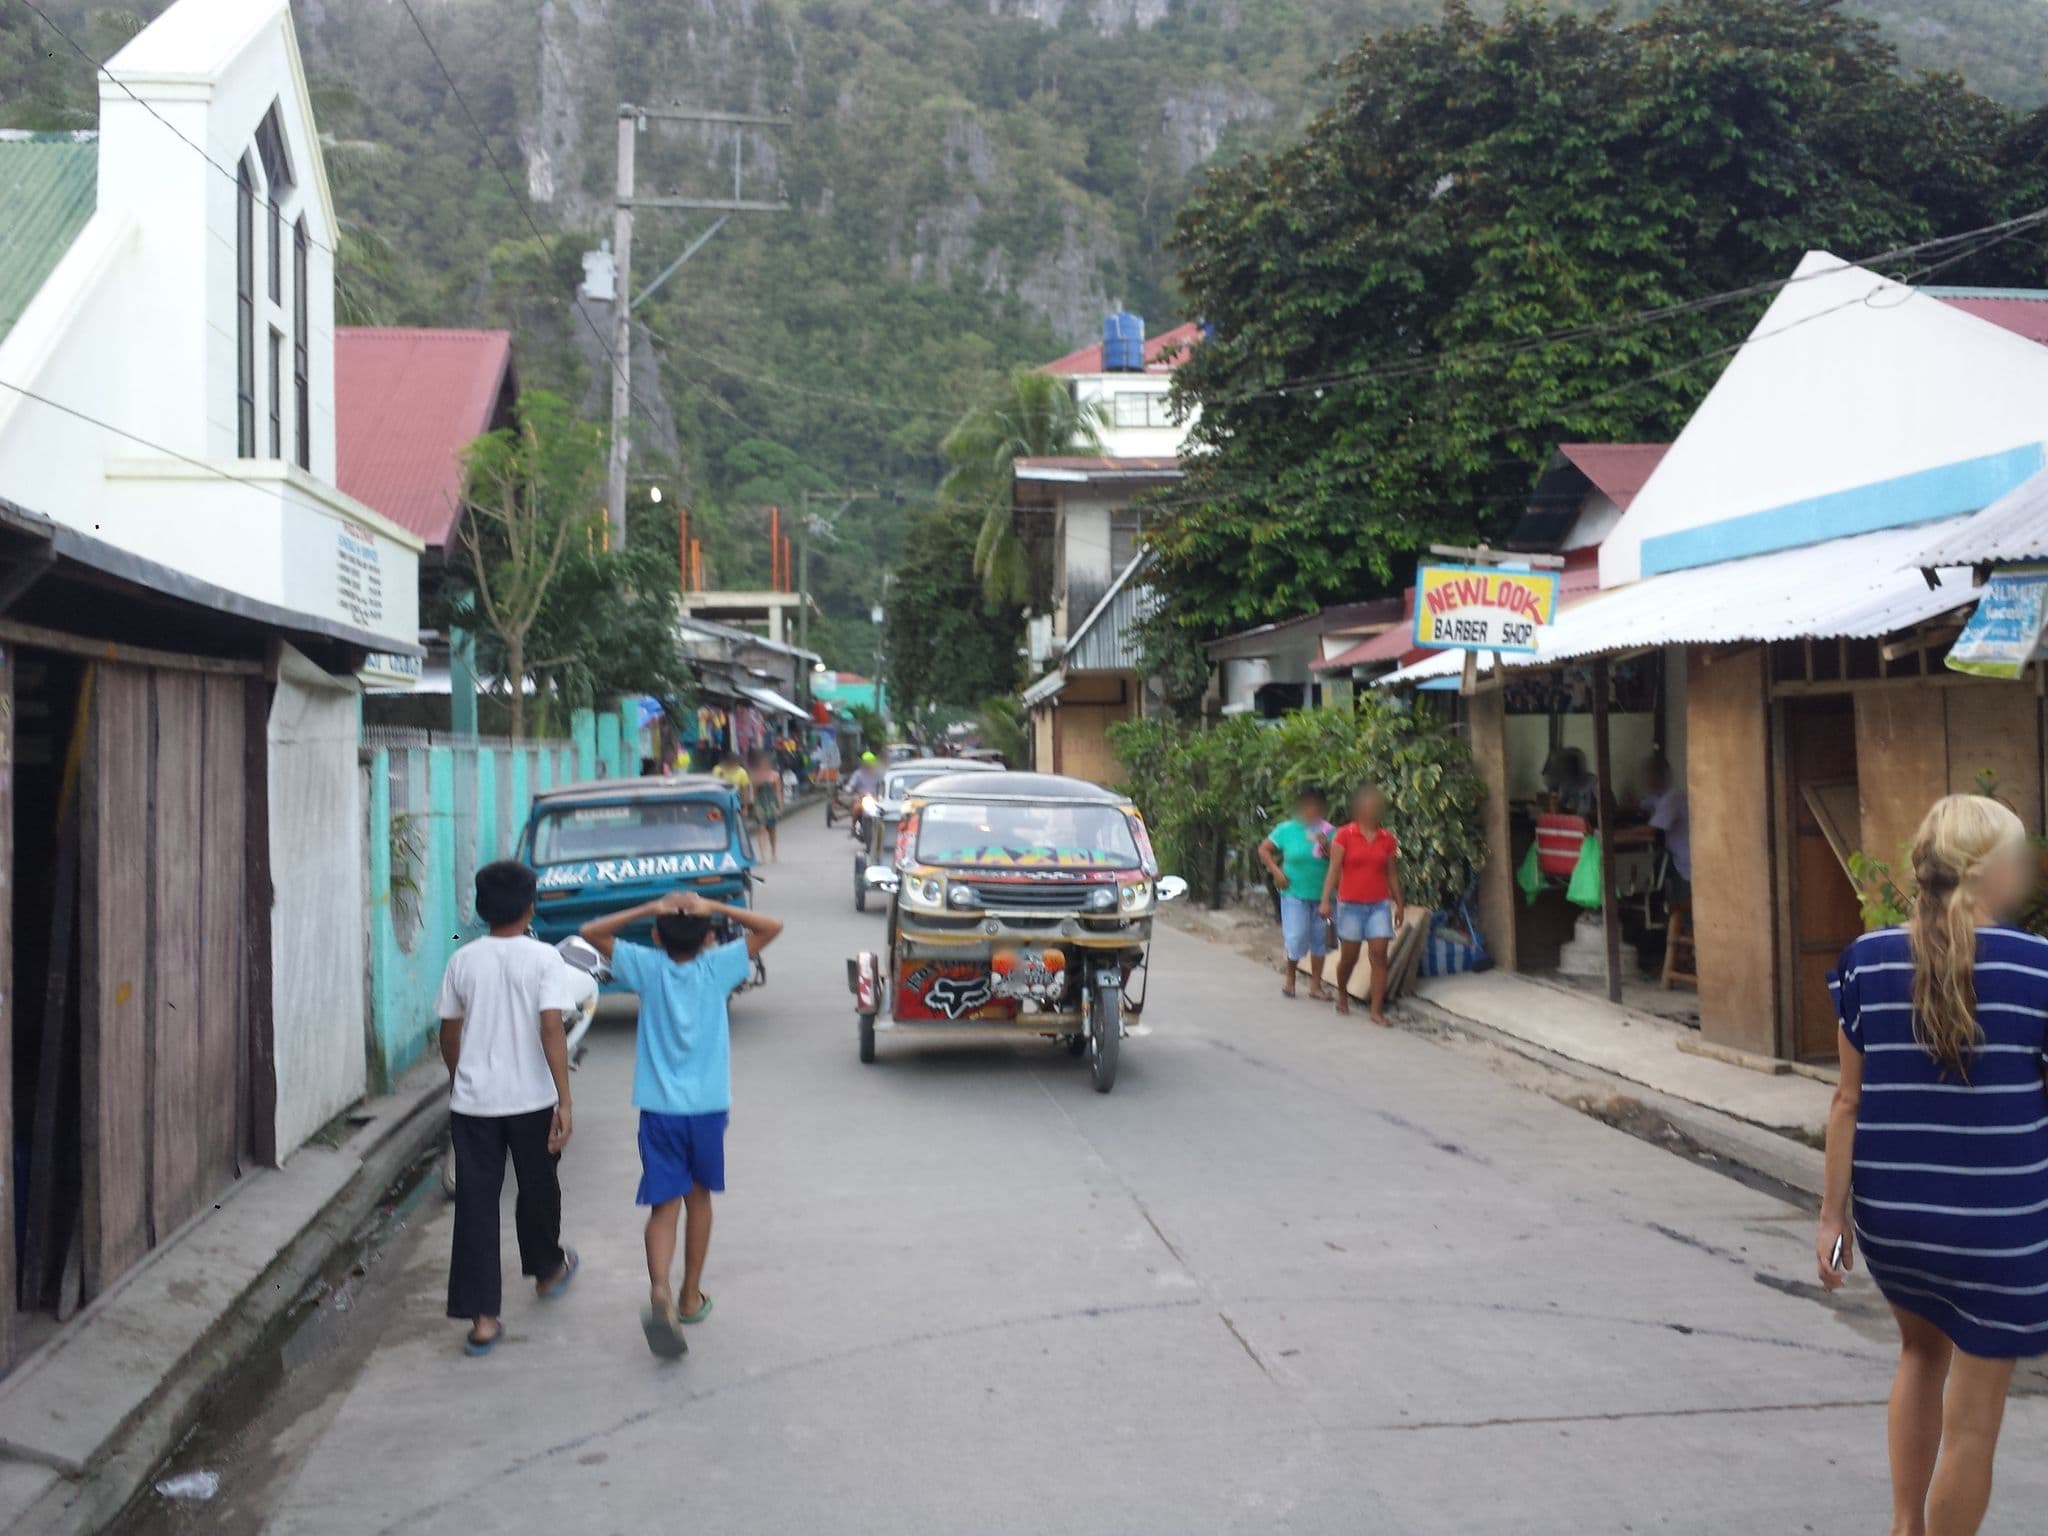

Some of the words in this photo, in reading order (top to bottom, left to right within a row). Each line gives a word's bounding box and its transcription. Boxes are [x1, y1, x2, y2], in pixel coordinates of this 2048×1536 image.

[1426, 576, 1543, 625] NEWLOOK
[1434, 618, 1488, 643] BARBER
[1501, 622, 1532, 645] SHOP
